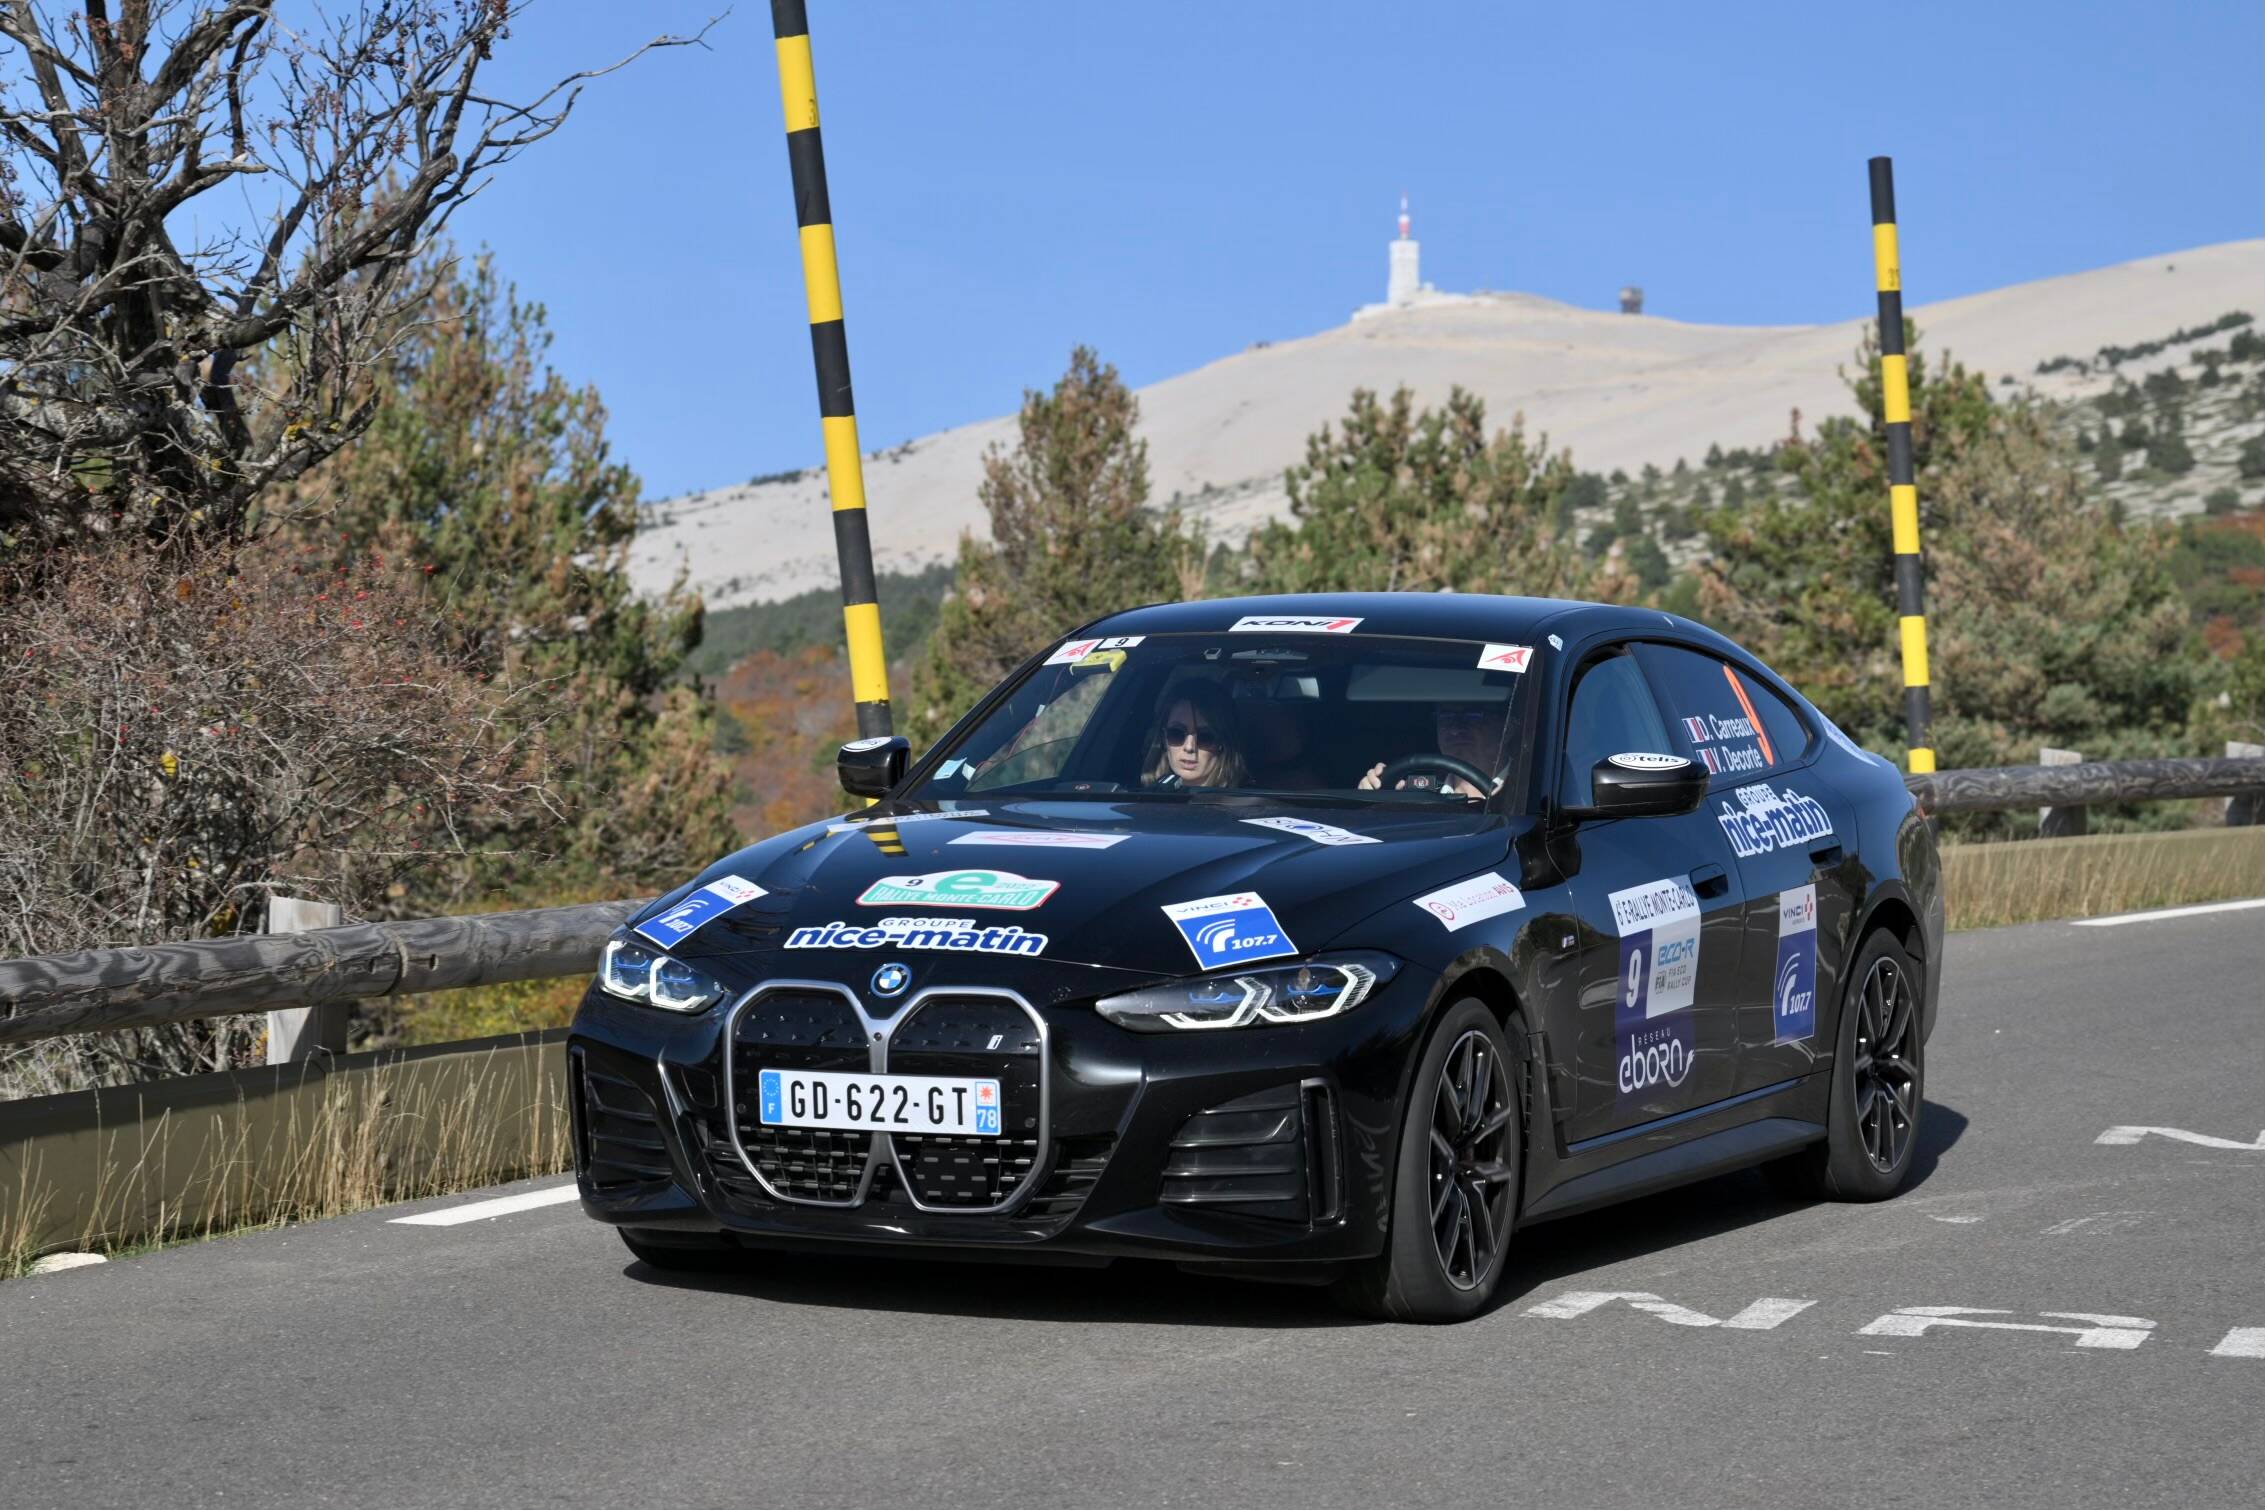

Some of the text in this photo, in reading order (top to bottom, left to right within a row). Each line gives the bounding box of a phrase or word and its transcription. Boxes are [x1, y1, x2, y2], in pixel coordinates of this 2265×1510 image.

[1722, 664, 1775, 768] 9
[1694, 715, 1714, 741] D.
[1720, 788, 1832, 856] nice-matin
[904, 878, 924, 887] 9
[872, 885, 1040, 906] RALLYE MONTE-CARLO
[1177, 902, 1229, 913] VINCI
[1783, 905, 1804, 919] VINCI
[882, 919, 971, 929] GROUPE
[789, 922, 1045, 954] nice-matin
[1231, 933, 1278, 950] 107.7
[1626, 948, 1642, 1009] 9
[1788, 991, 1812, 1015] 107.7
[767, 1102, 776, 1115] F
[789, 1079, 968, 1127] GD-622-GT
[976, 1108, 998, 1129] 78
